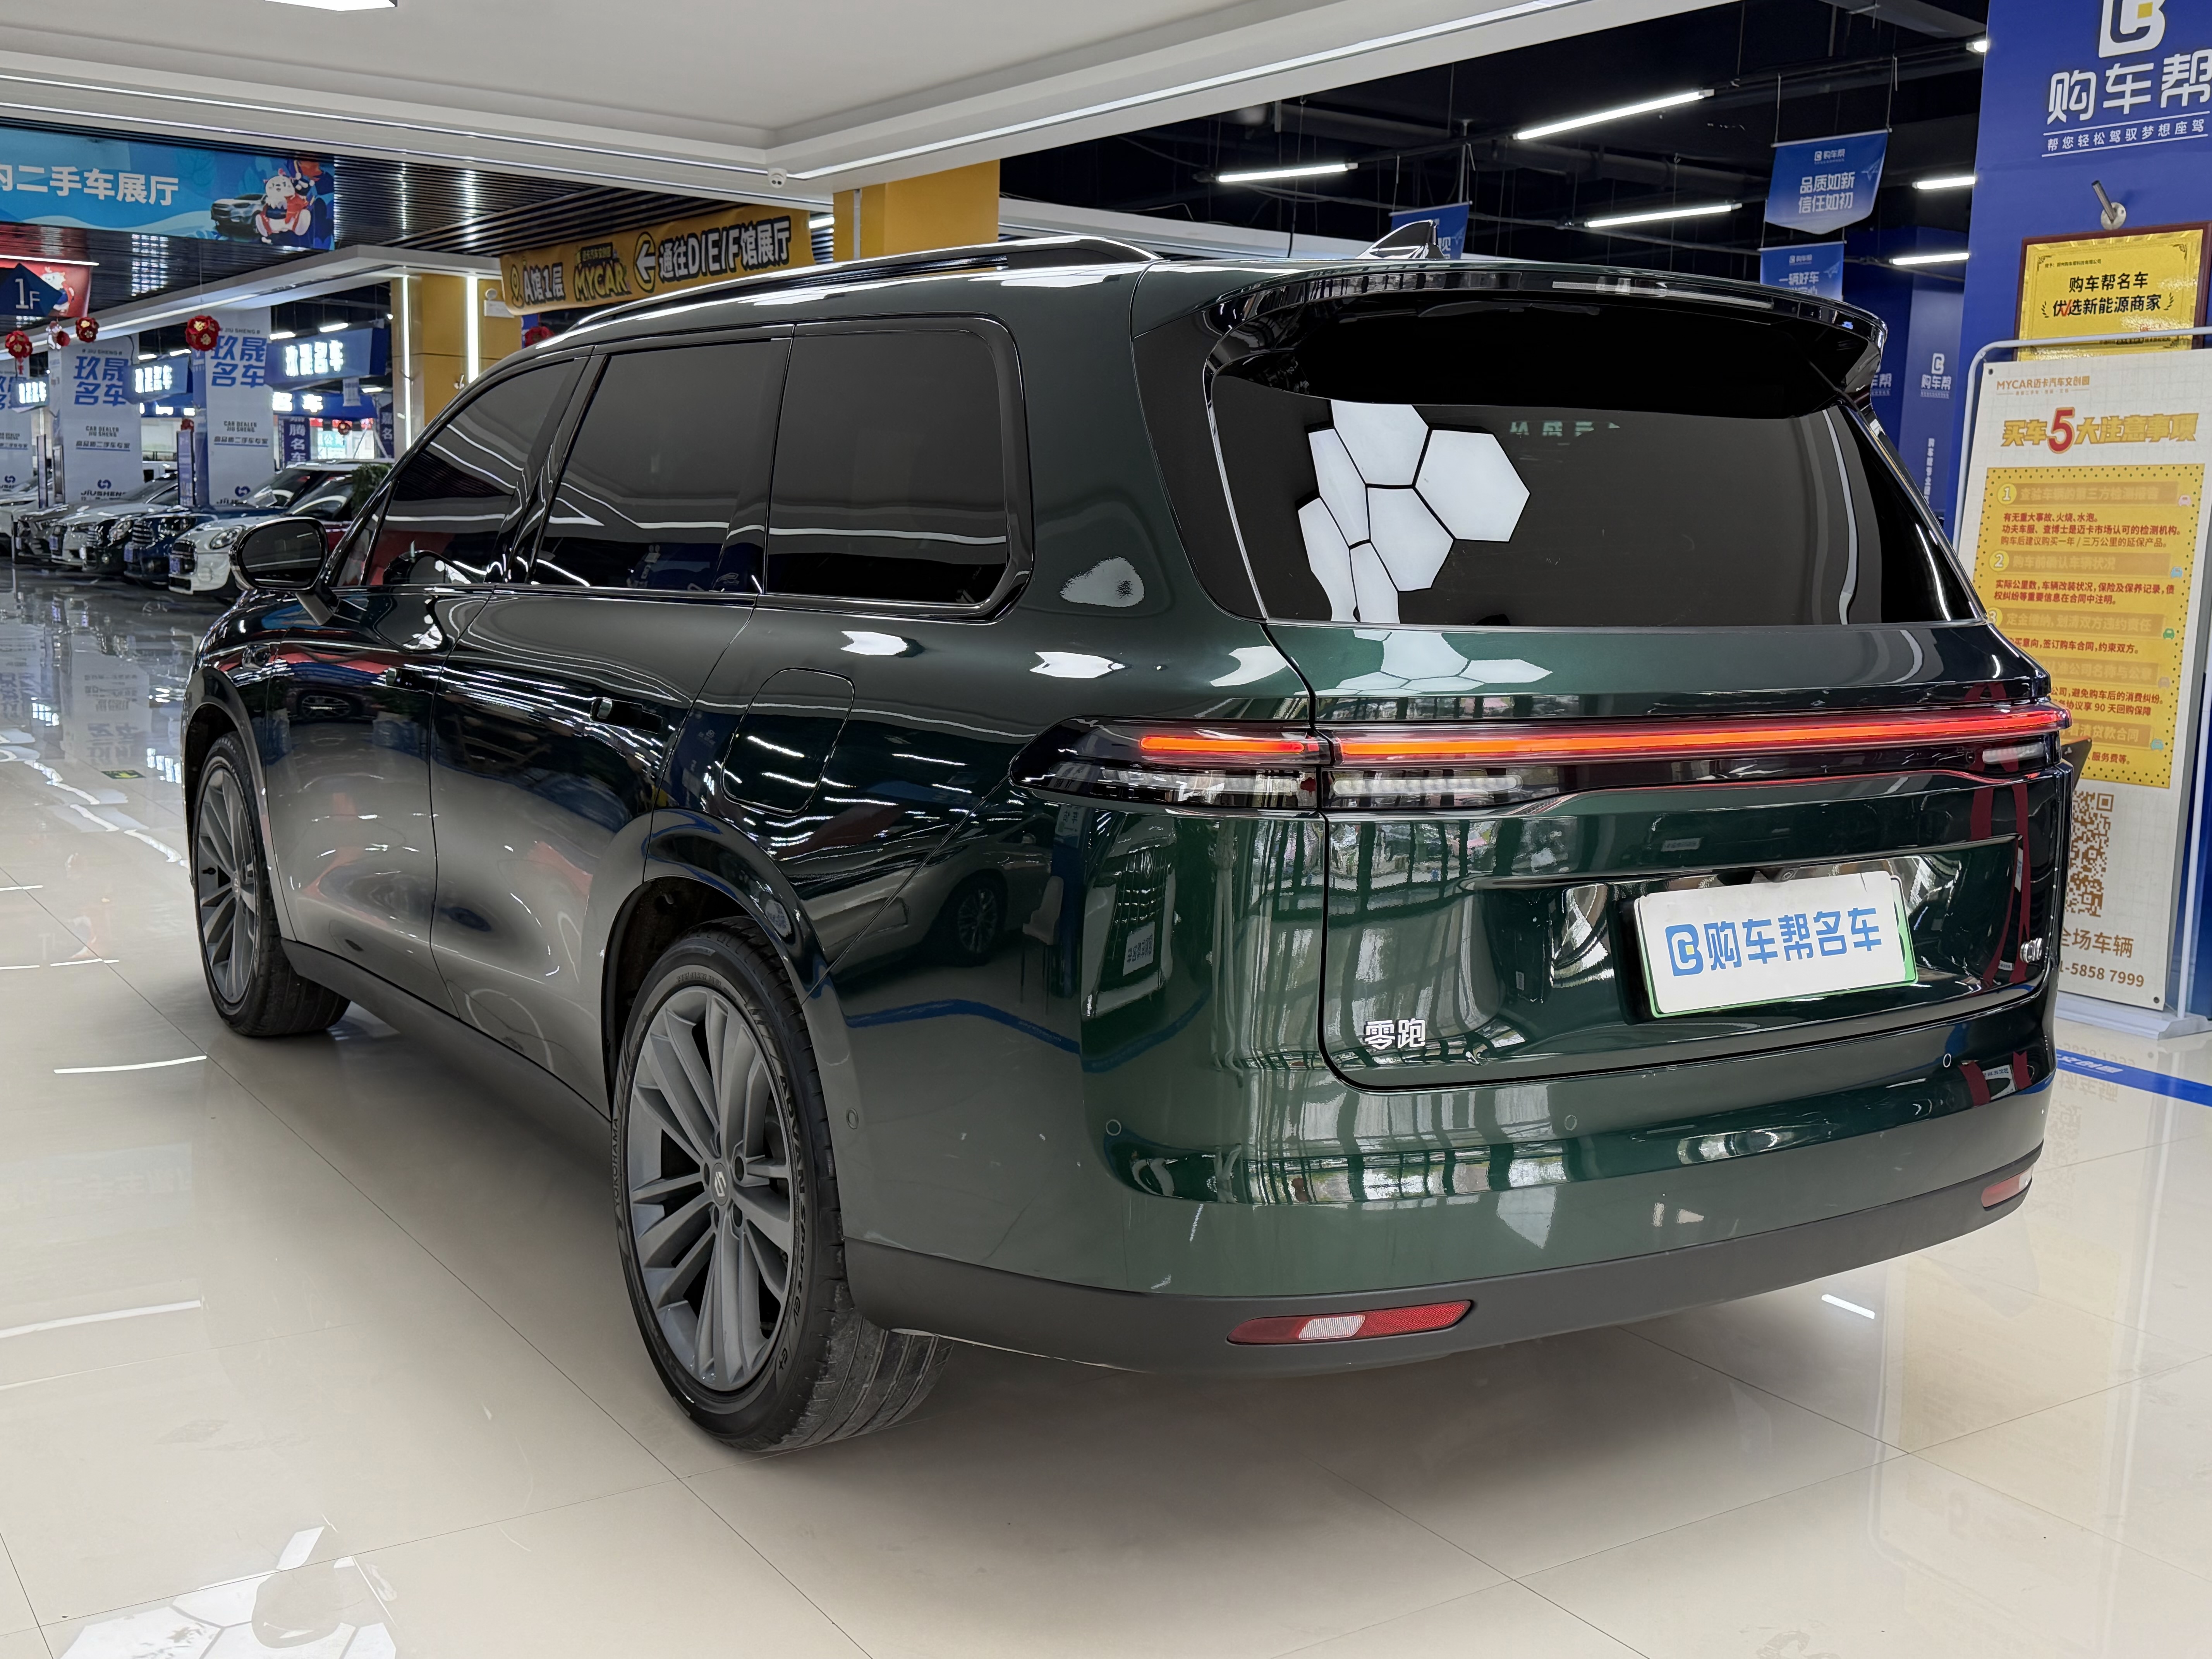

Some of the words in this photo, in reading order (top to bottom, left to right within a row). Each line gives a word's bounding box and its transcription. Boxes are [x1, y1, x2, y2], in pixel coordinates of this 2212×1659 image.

[2047, 49, 2212, 125] 购车帮
[2048, 119, 2204, 151] 帮您轻松驾驭梦想座驾
[1800, 172, 1855, 193] 品质如新
[1798, 192, 1853, 213] 信任如初
[15, 278, 40, 309] 1F
[523, 263, 565, 303] A馆1层
[575, 262, 628, 301] MYCAR
[2069, 272, 2148, 292] 购车帮名车
[2053, 294, 2161, 317] 优选新能源商家
[211, 362, 265, 388] 名车
[74, 381, 126, 407] 名车
[2001, 407, 2198, 453] 买车5大注意事项
[2002, 487, 2011, 501] 1
[1995, 555, 2004, 567] 2
[2095, 703, 2105, 712] 90
[2108, 704, 2151, 716] 天回购保障
[1705, 907, 1882, 971] 购车帮名车
[2110, 970, 2144, 988] 7999
[1365, 1018, 1426, 1049] 零跑
